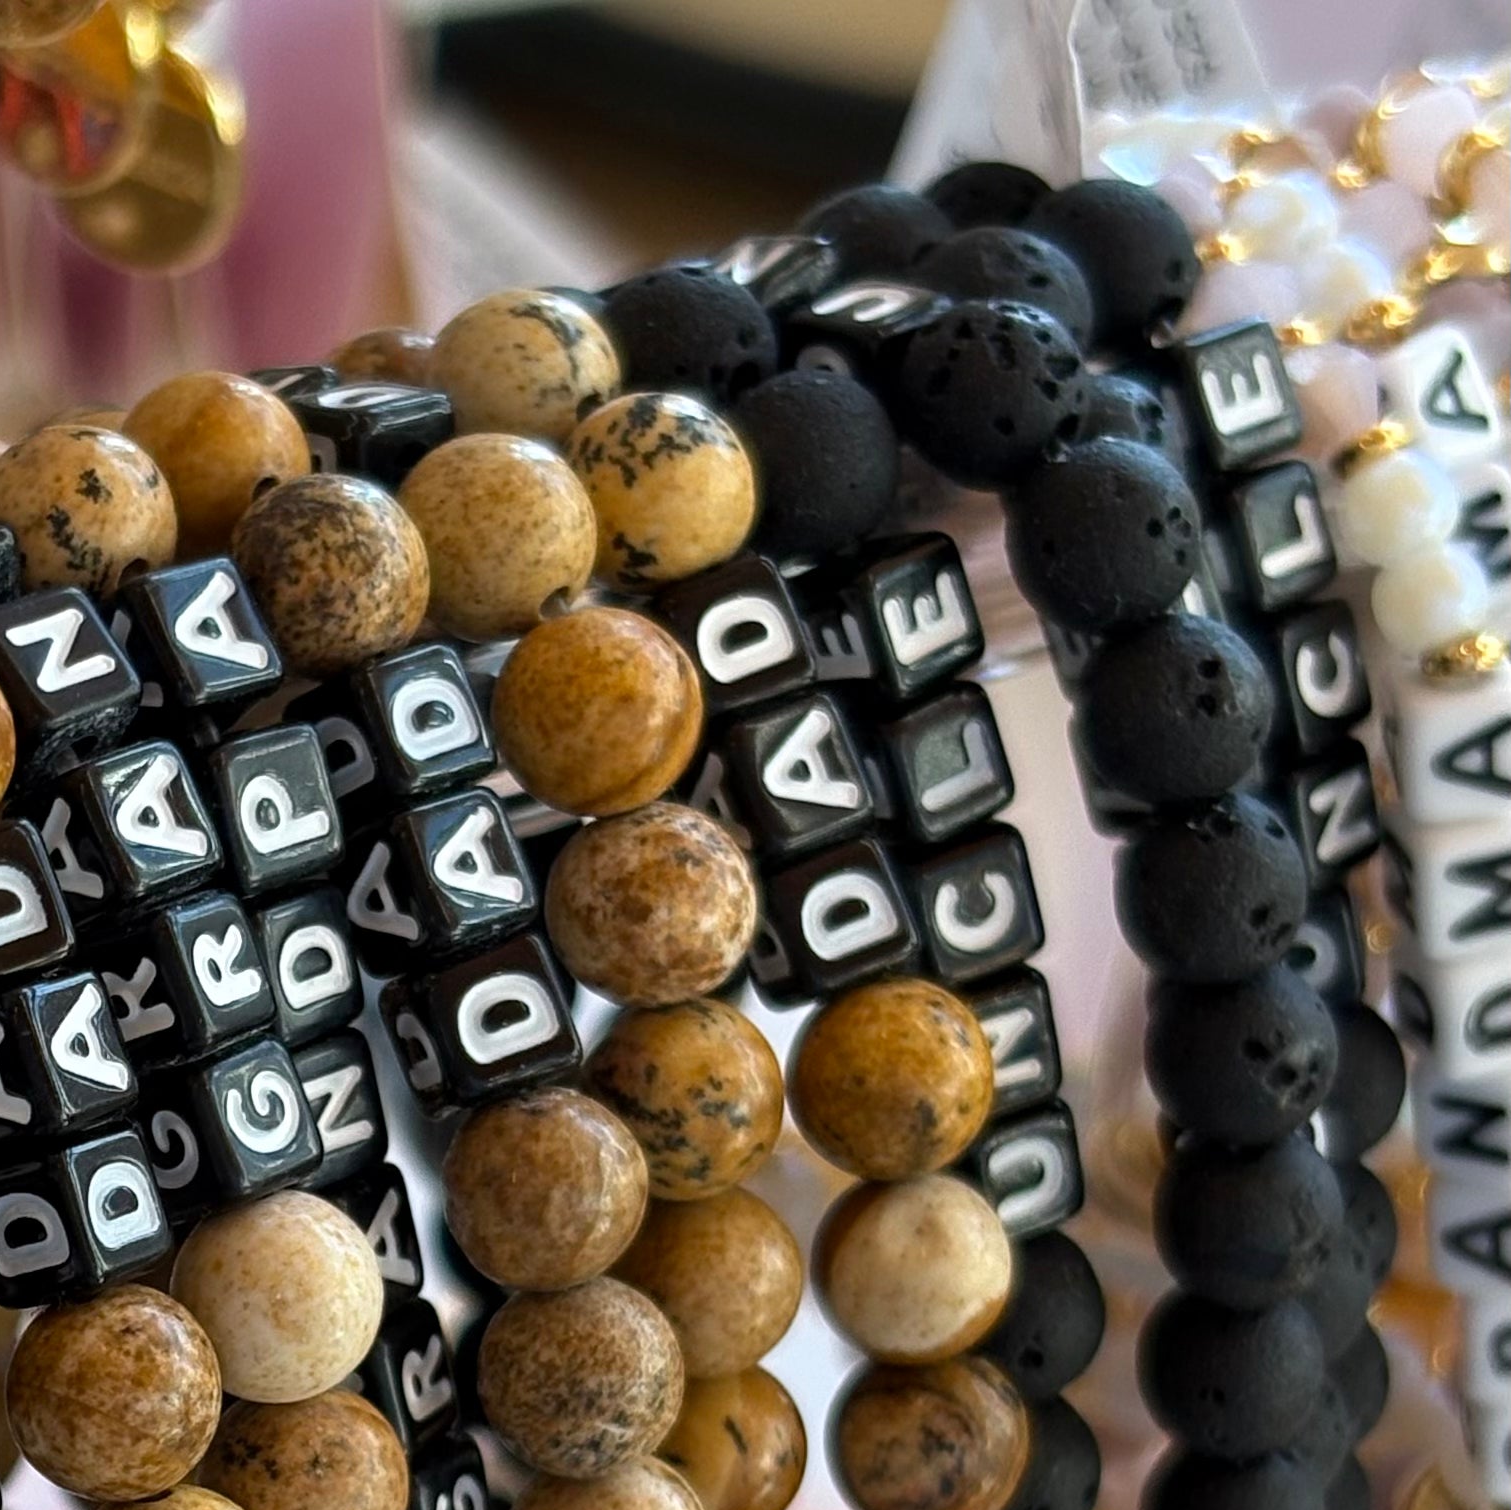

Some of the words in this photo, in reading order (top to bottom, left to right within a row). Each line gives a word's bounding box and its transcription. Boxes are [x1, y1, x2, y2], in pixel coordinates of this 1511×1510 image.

[391, 678, 559, 1065] DAD
[698, 596, 899, 962] DAD
[882, 571, 1065, 1235] UNCLE
